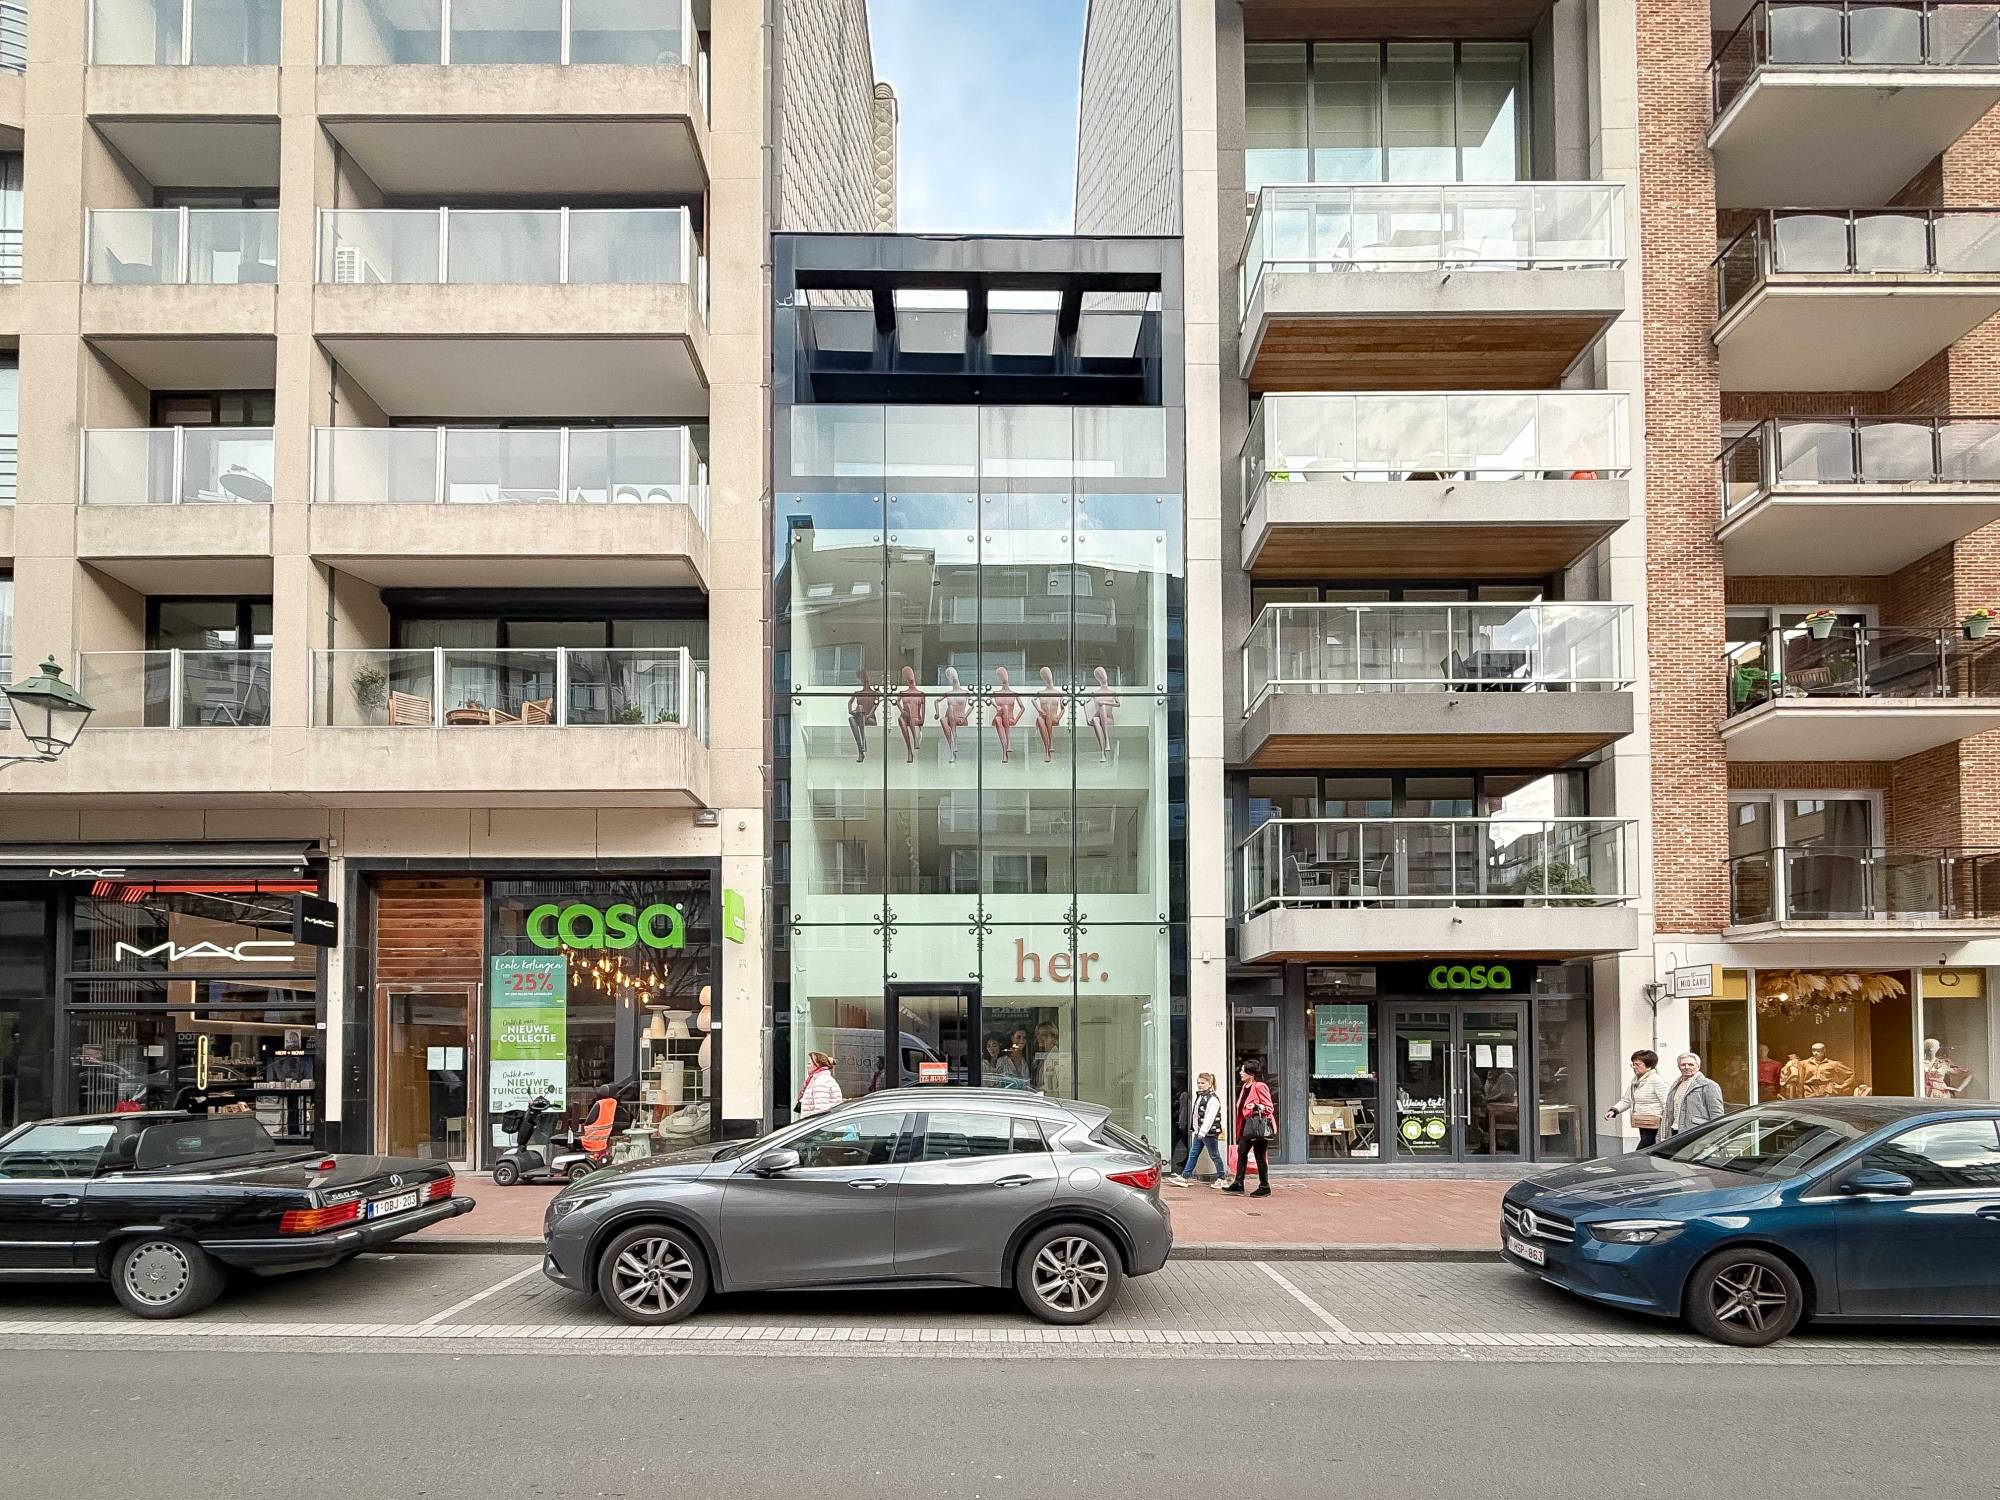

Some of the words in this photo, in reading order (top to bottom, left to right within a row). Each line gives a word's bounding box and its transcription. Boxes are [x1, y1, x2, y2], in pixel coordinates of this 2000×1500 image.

[526, 903, 684, 949] casa
[495, 958, 520, 970] Lente
[1013, 938, 1109, 983] her.
[504, 972, 554, 991] -25%
[1428, 965, 1512, 990] casa
[507, 1025, 550, 1034] NIEUWE
[500, 1034, 557, 1043] COLLECTIE
[507, 1079, 550, 1087] NIEUWE
